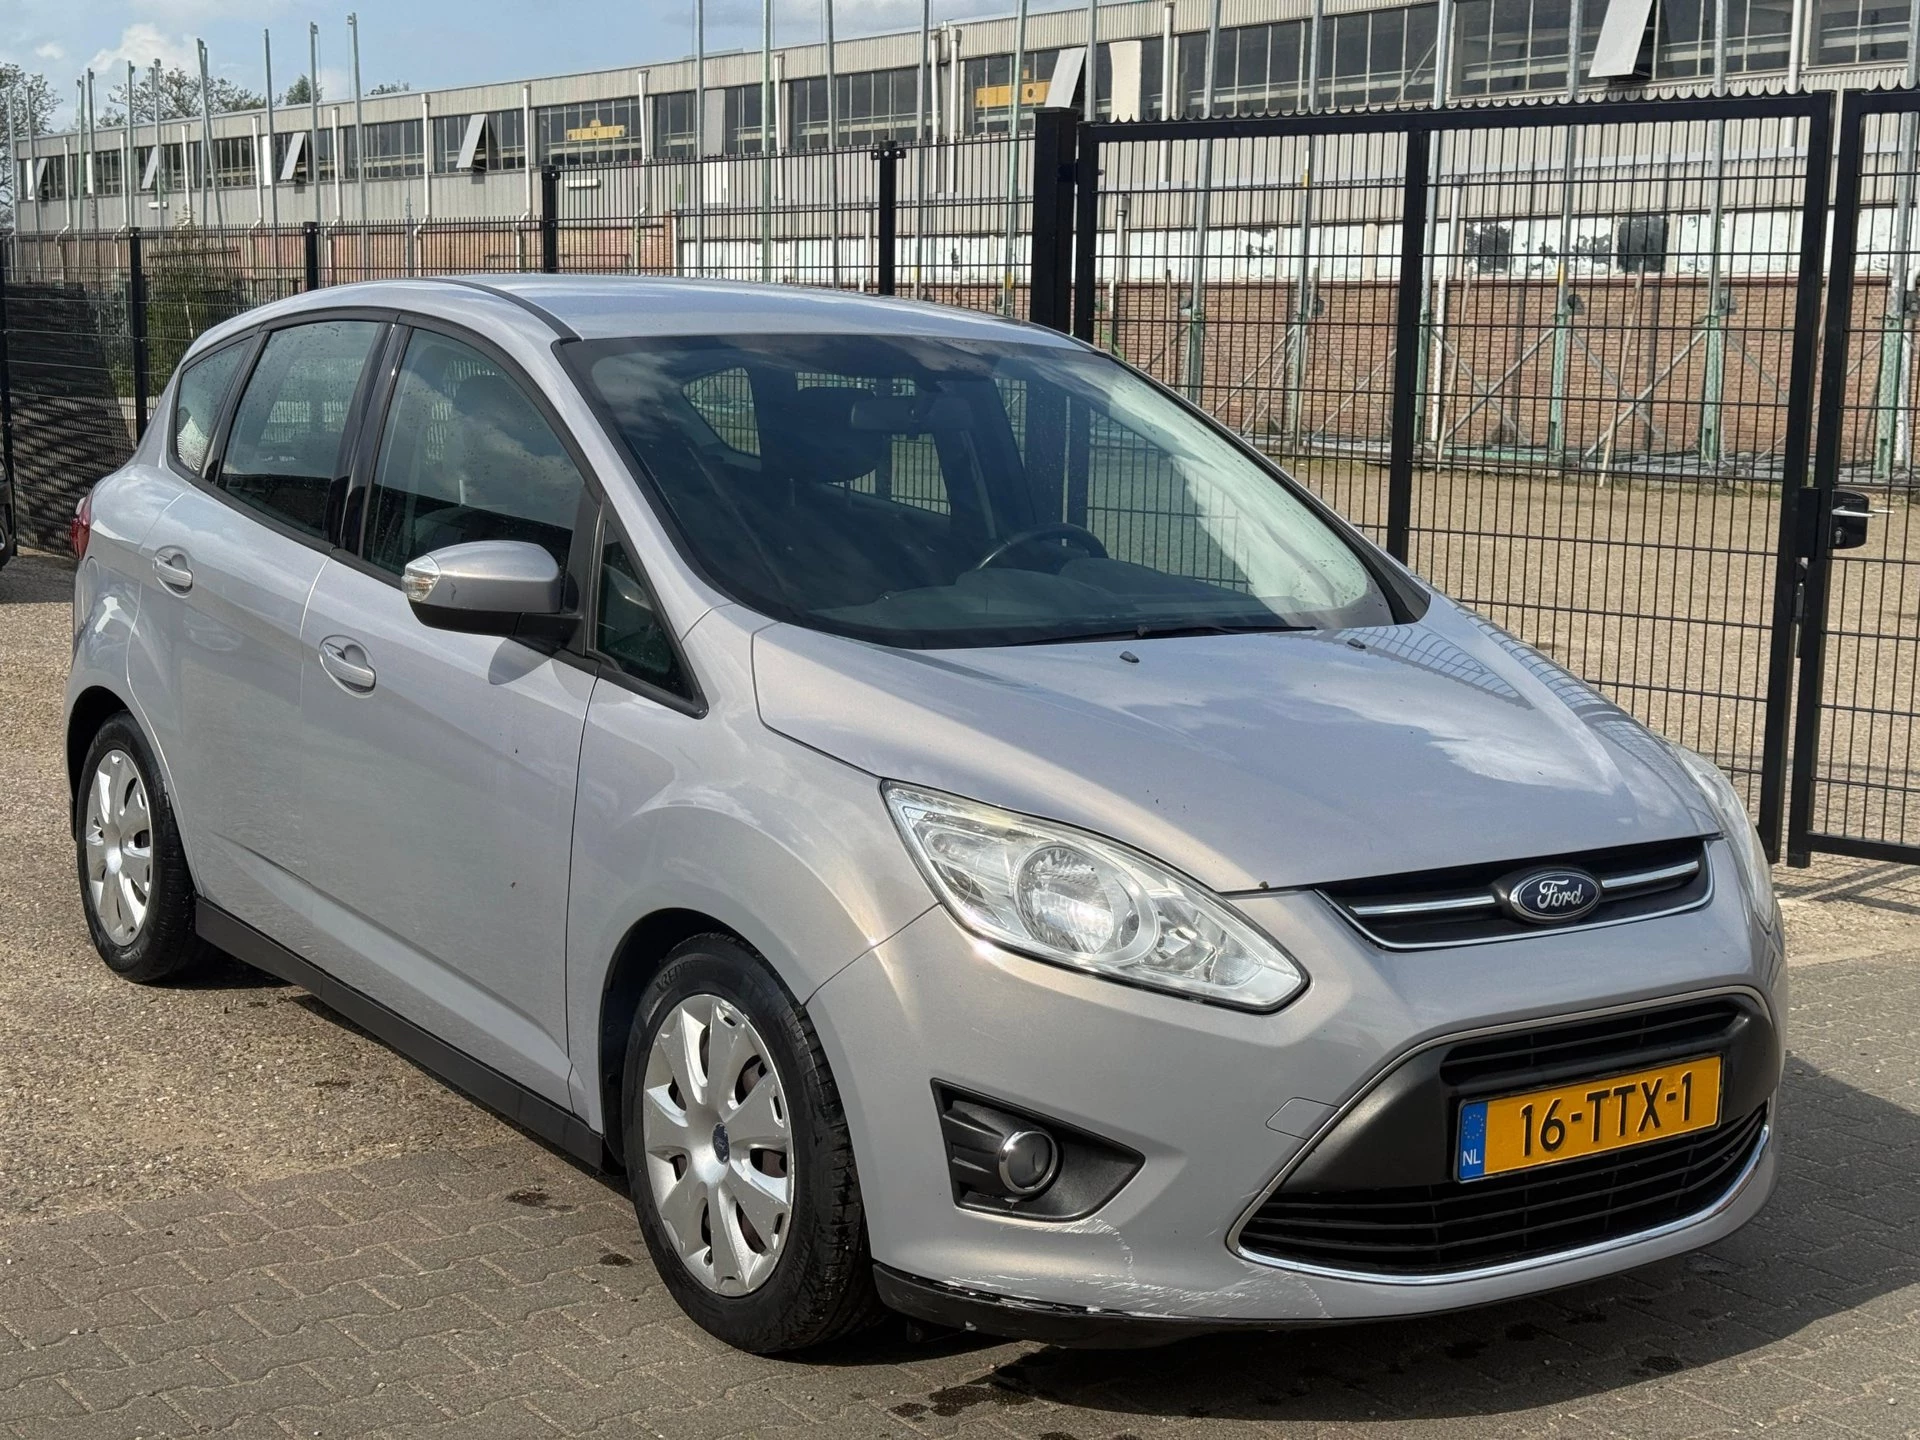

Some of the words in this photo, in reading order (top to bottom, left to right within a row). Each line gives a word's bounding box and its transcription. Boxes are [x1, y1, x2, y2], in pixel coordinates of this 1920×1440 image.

[1537, 879, 1584, 909] Ford
[1520, 1071, 1692, 1157] 16-TTX-1
[1463, 1149, 1481, 1166] NL
